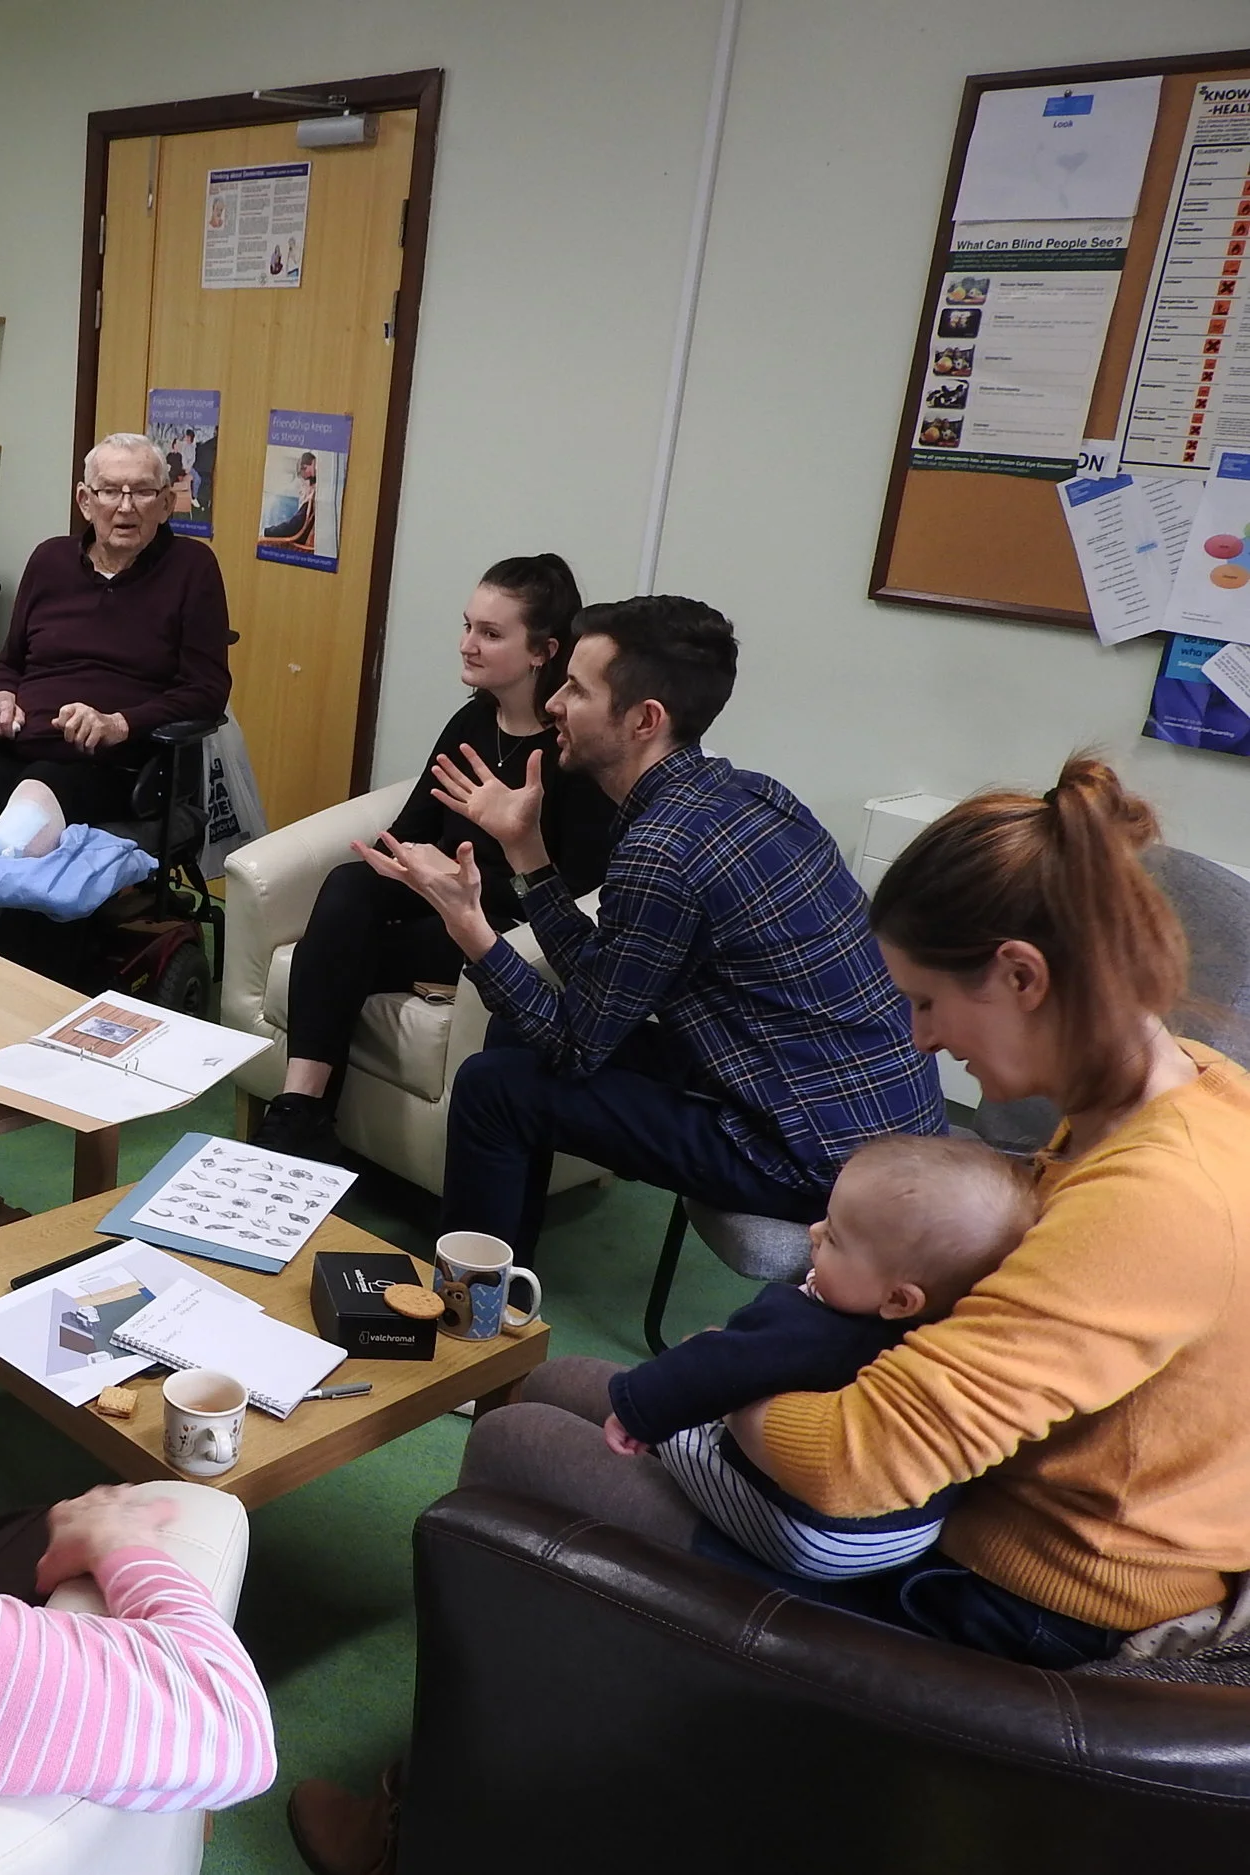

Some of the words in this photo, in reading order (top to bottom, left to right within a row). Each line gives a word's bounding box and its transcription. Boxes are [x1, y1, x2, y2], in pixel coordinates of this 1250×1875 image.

[957, 240, 984, 250] What
[986, 239, 1008, 250] Can
[1012, 238, 1043, 249] Blind
[1046, 238, 1087, 250] People
[1091, 237, 1123, 248] See?
[370, 1334, 416, 1343] valchromat
